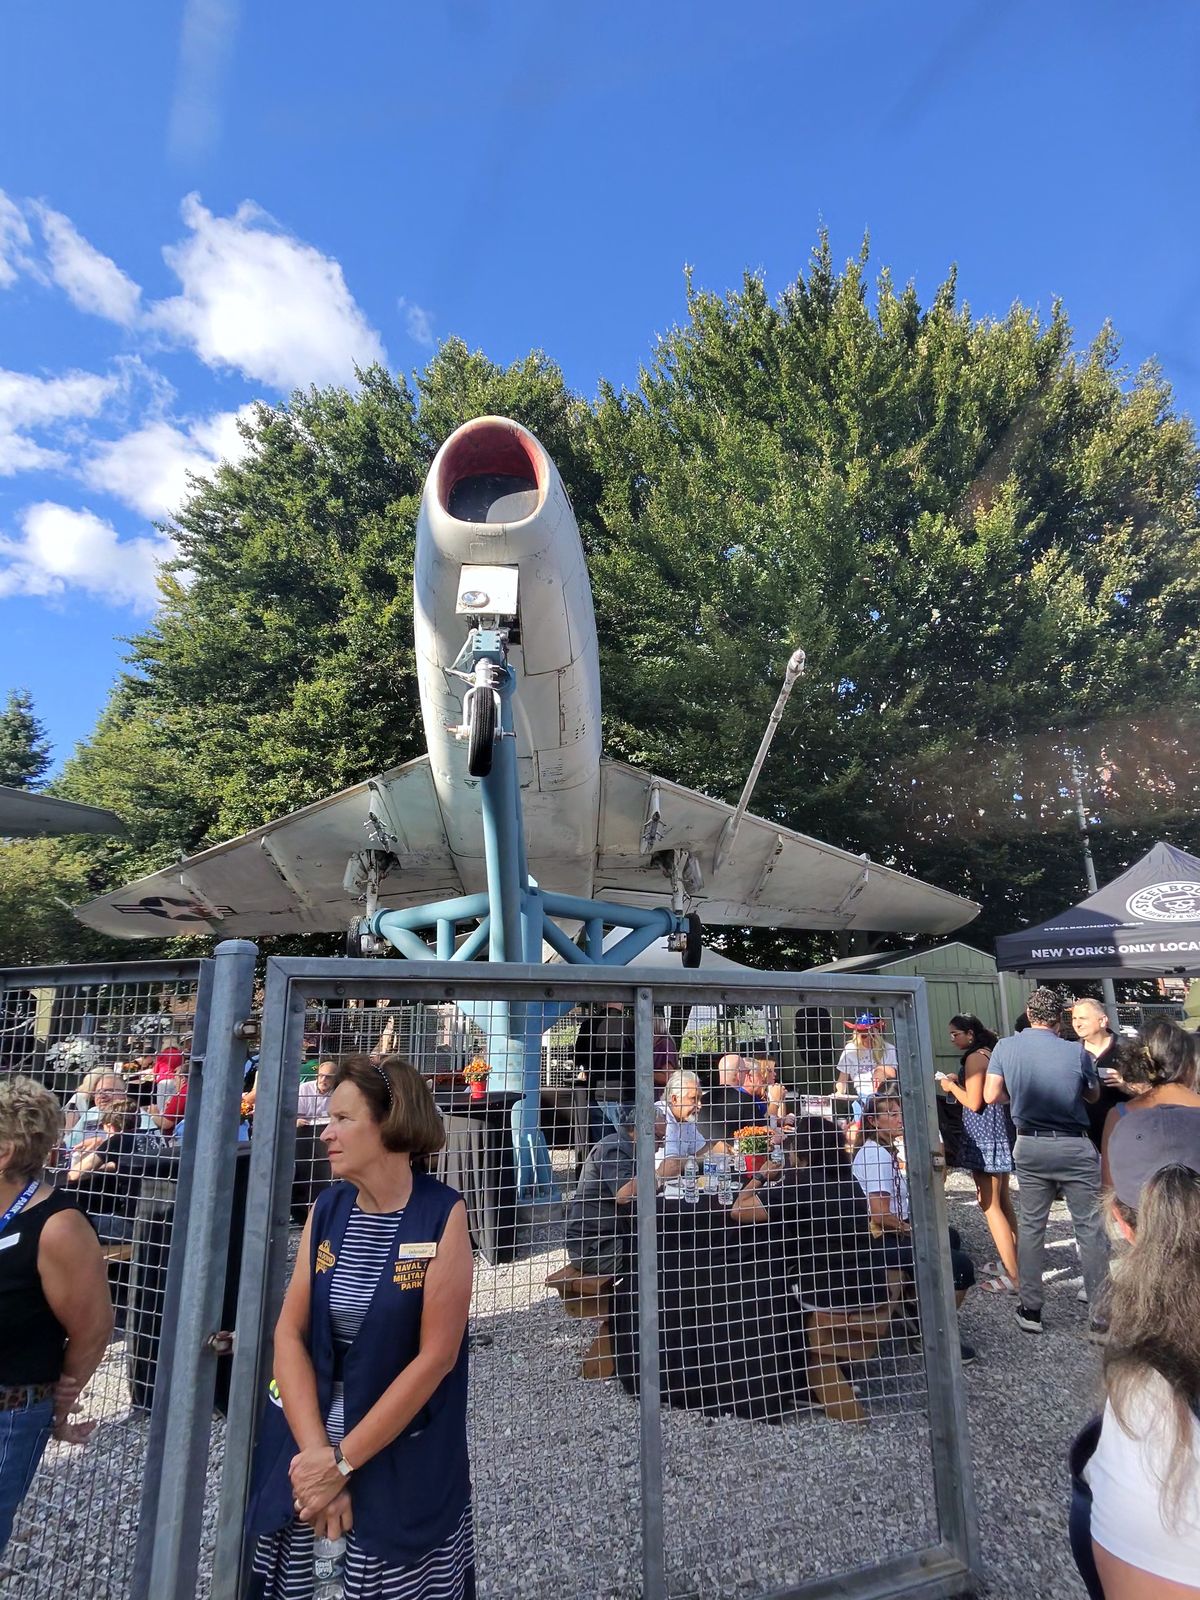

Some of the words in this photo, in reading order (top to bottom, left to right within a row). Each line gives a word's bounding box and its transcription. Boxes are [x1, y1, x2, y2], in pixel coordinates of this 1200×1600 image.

[1031, 948, 1064, 958] NEW
[1066, 945, 1116, 957] YORK'S
[1118, 943, 1156, 954] ONLY
[1159, 941, 1200, 952] LOCA
[395, 1262, 422, 1273] NAVAL
[400, 1280, 423, 1291] PARK
